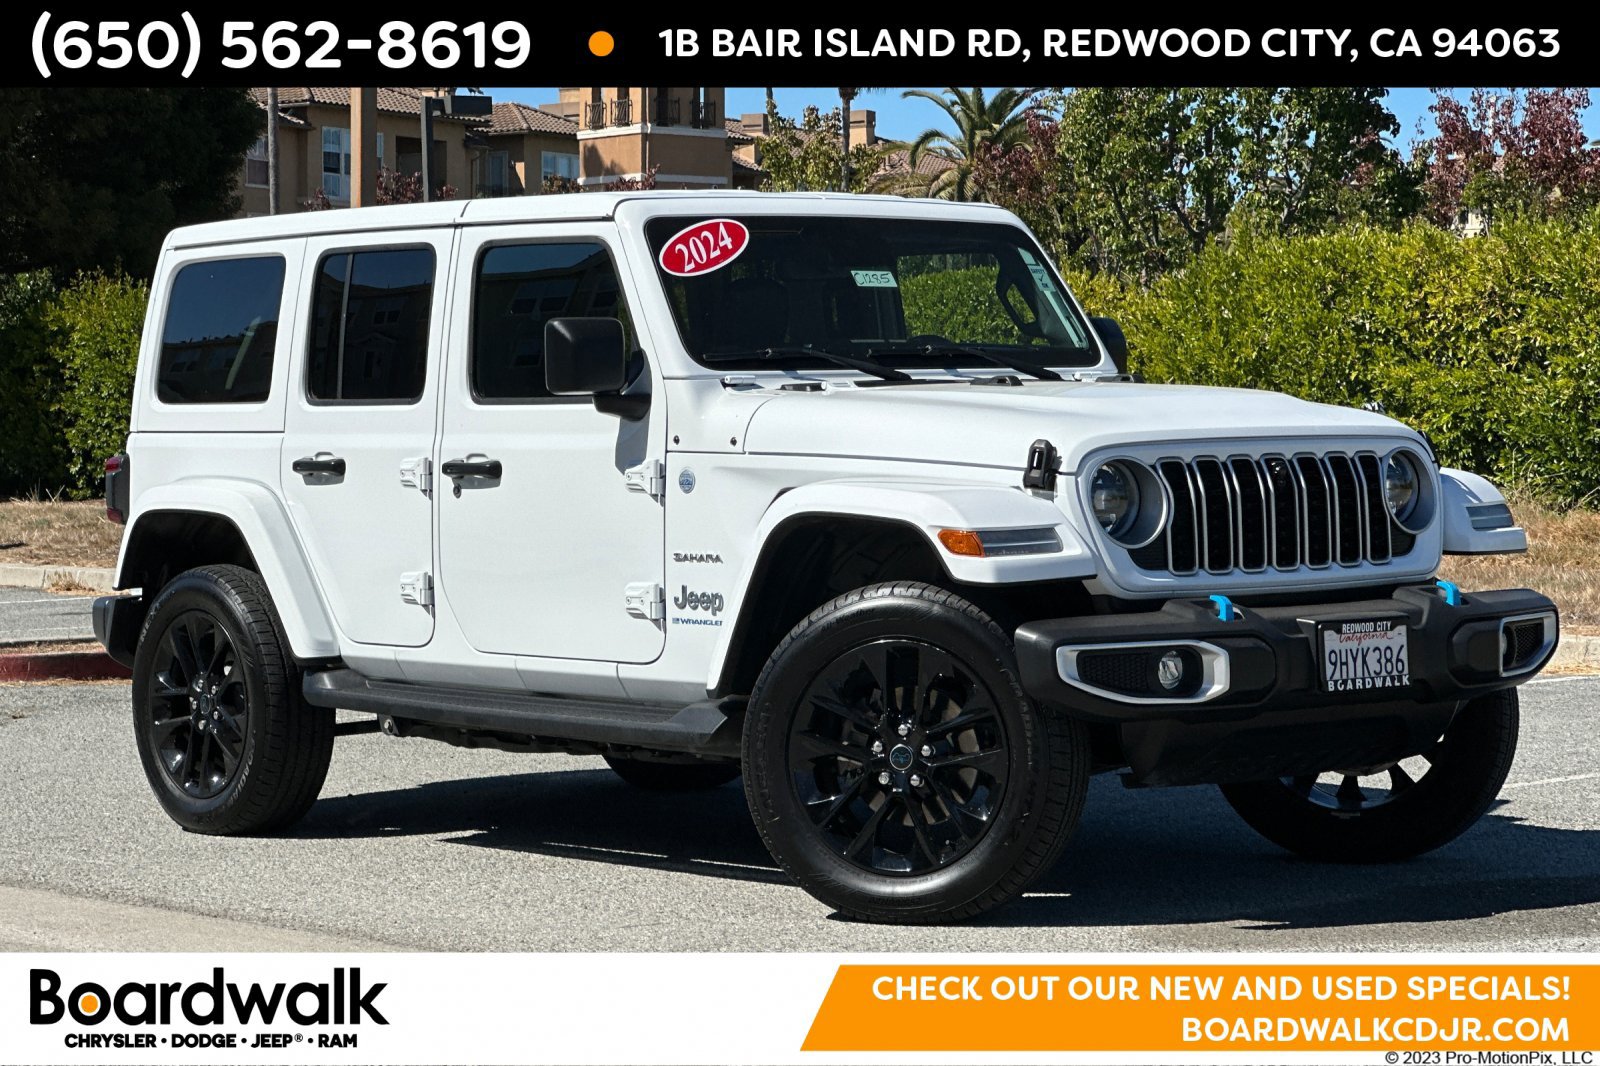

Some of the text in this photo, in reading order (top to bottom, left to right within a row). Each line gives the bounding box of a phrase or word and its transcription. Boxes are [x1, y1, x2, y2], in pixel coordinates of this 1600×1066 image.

[675, 222, 733, 272] 2024
[673, 553, 723, 564] SAHARA
[674, 585, 724, 616] Jeep
[1342, 621, 1392, 634] REDWOOD CITY
[1328, 644, 1405, 680] 9HYK386
